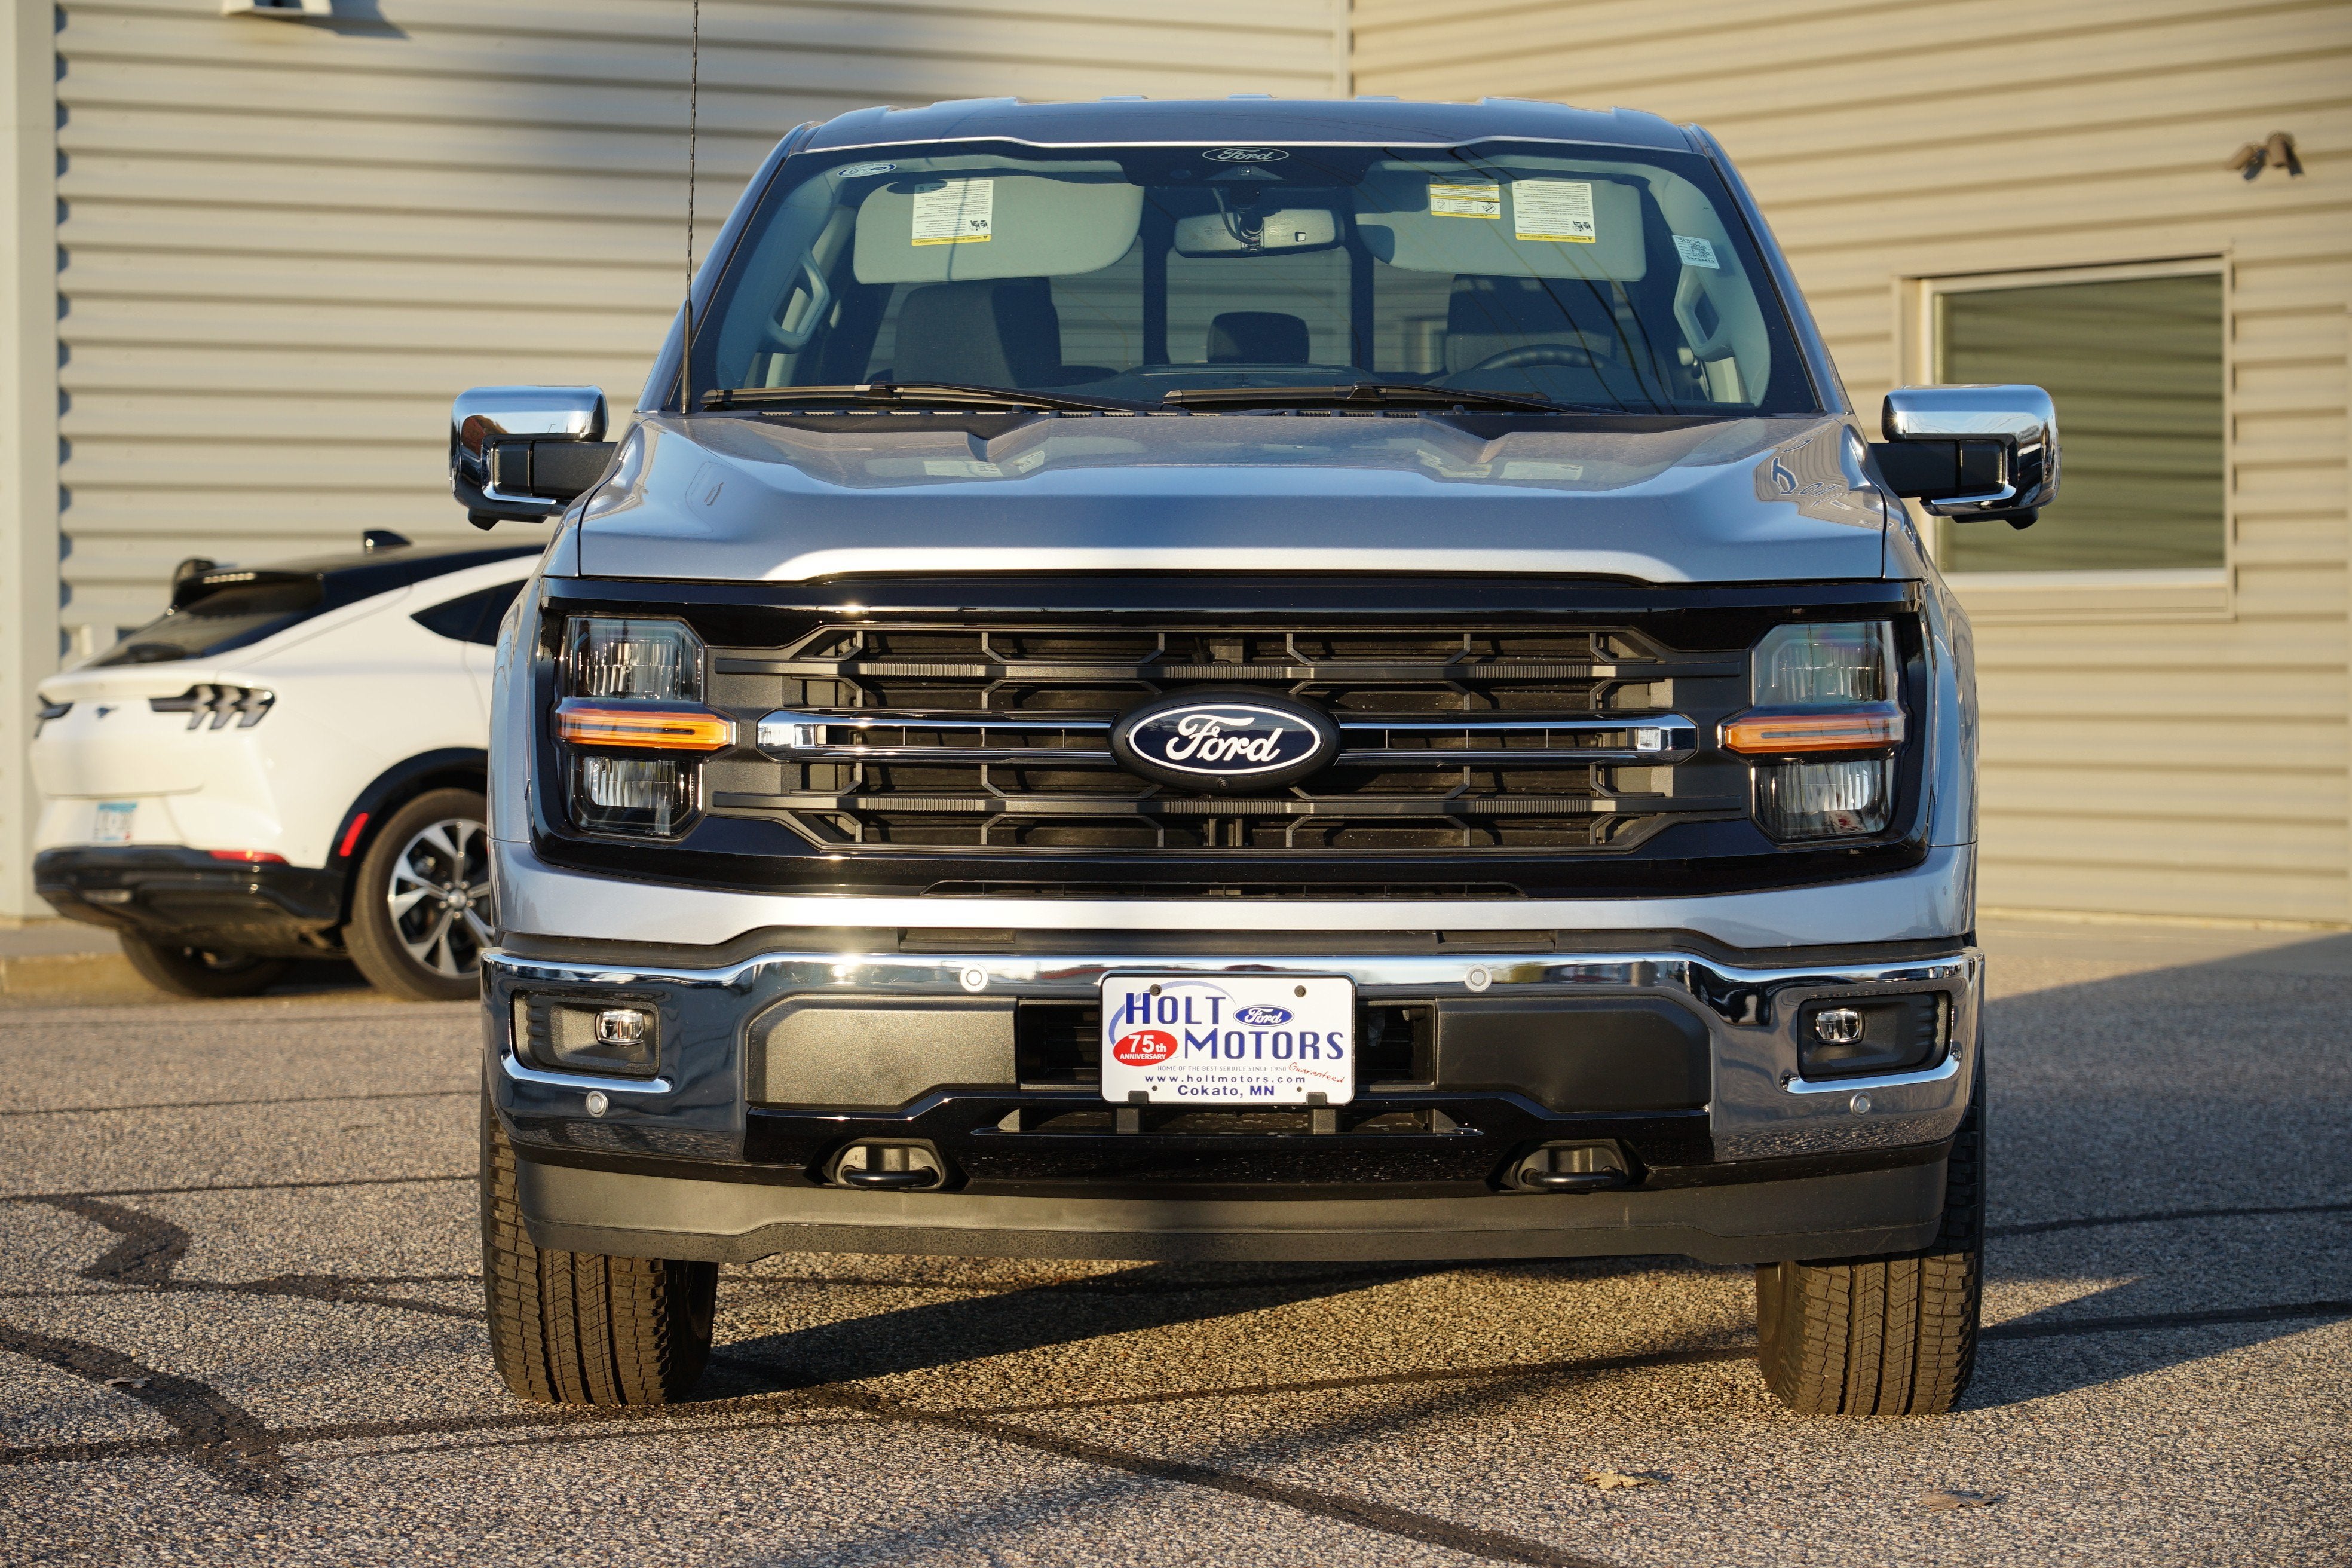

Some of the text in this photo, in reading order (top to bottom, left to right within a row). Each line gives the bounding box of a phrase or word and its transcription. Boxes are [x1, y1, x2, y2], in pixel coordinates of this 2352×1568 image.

[1217, 149, 1274, 160] Ford
[1166, 714, 1284, 762] Ford
[1126, 993, 1226, 1025] HOLT
[1244, 1007, 1283, 1024] Ford
[1128, 1034, 1167, 1054] 75th
[1184, 1027, 1344, 1060] MOTORS
[1288, 1062, 1345, 1083] Guaranteed
[1178, 1085, 1275, 1098] Cokato, MN
